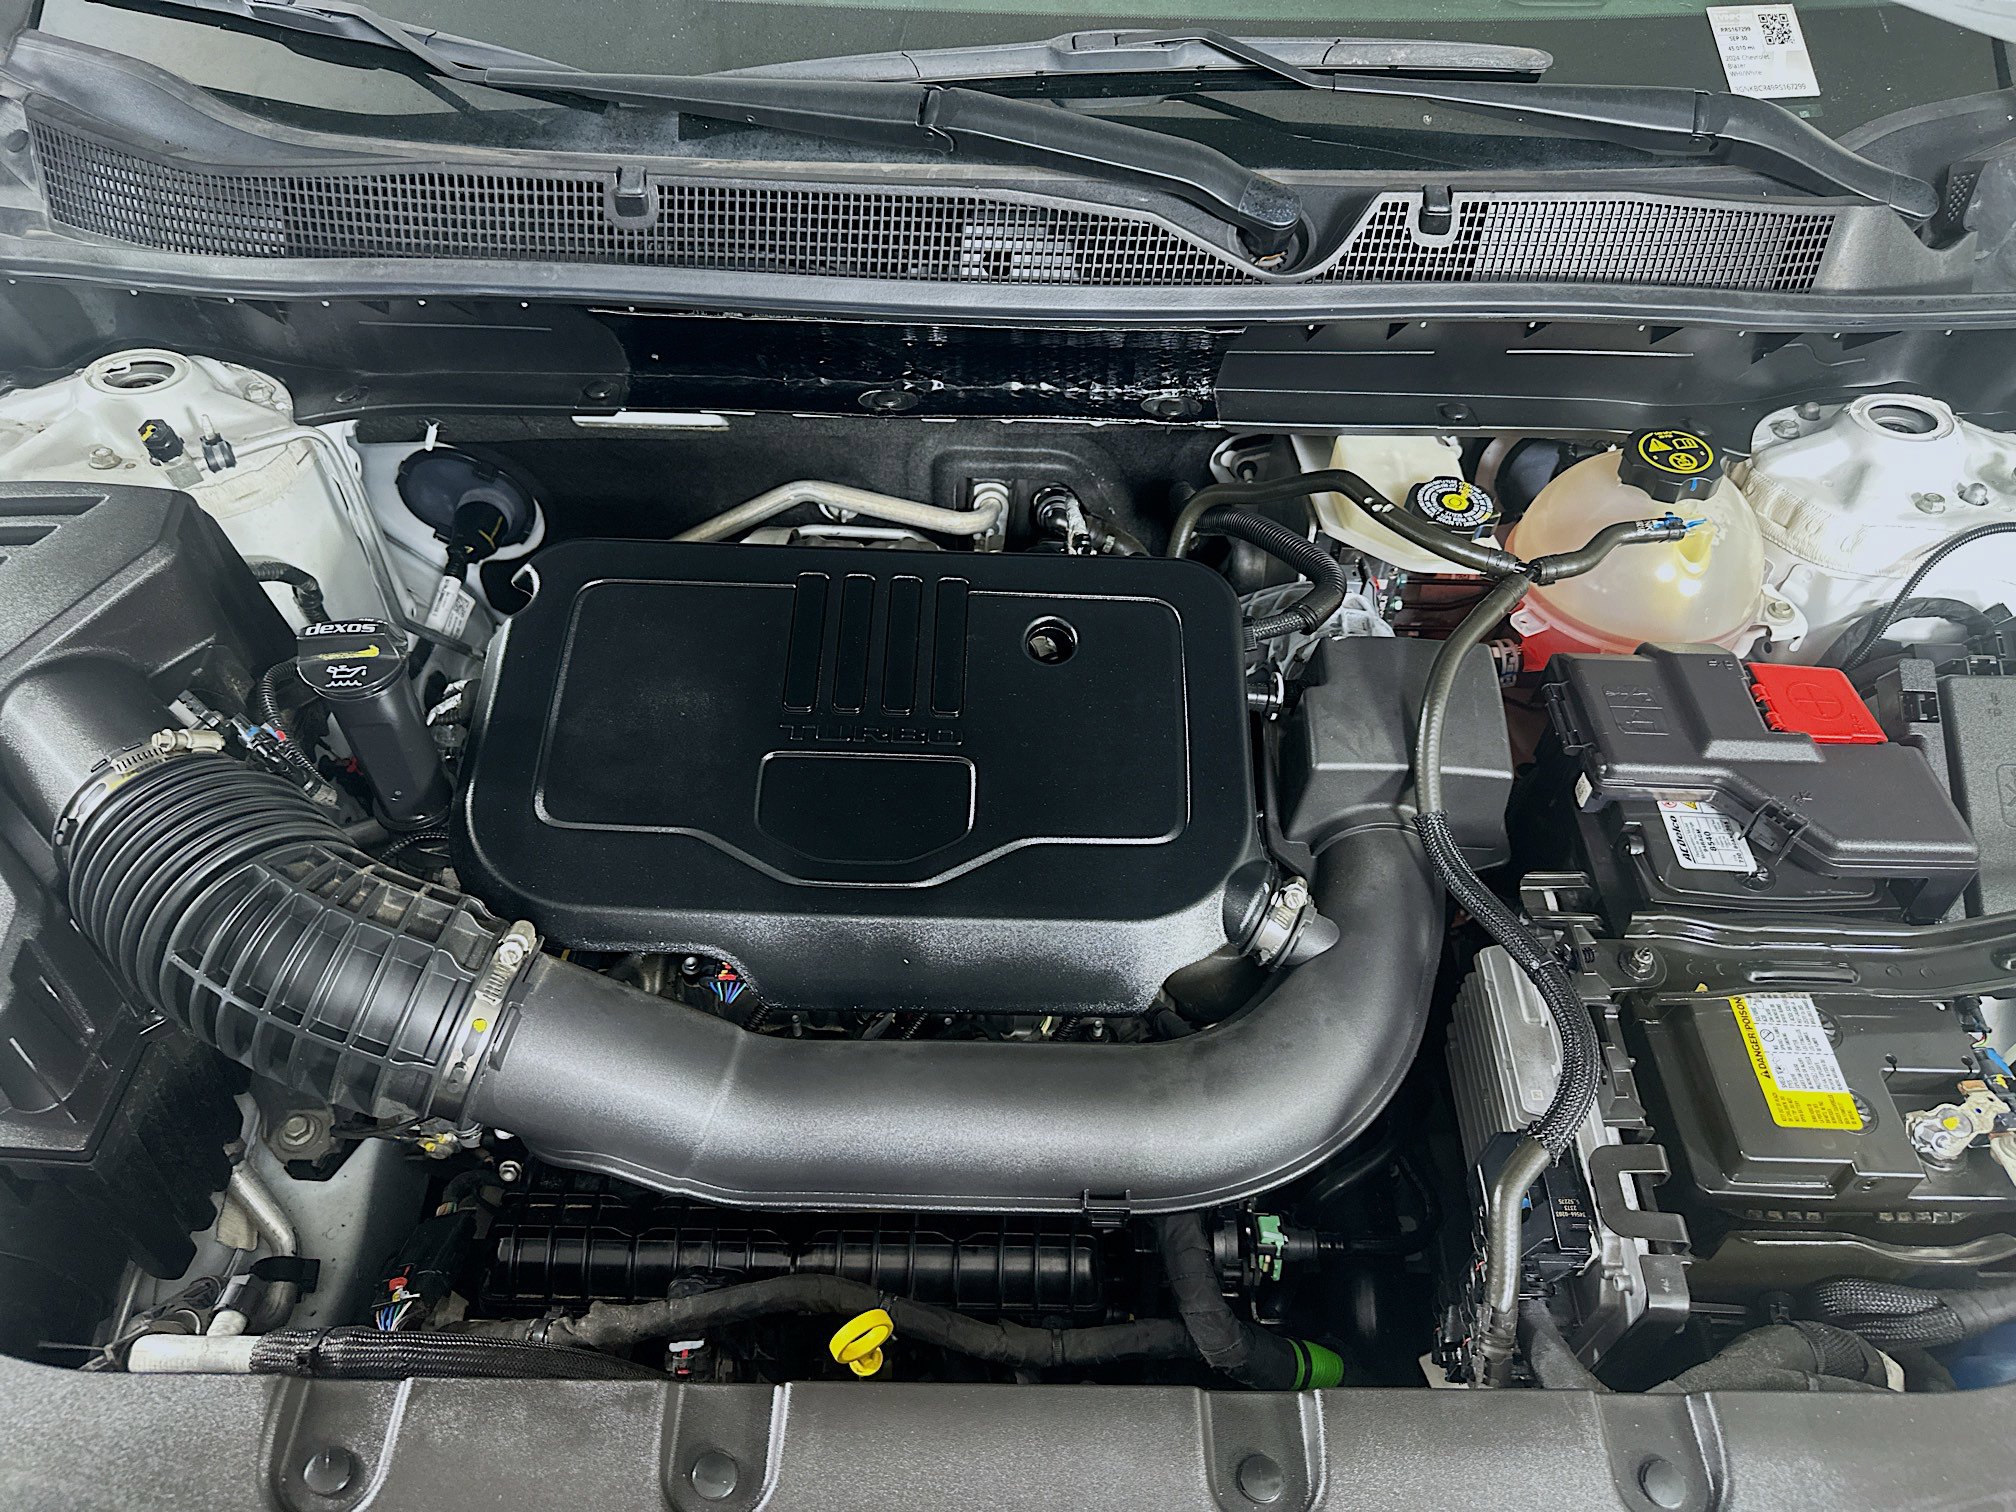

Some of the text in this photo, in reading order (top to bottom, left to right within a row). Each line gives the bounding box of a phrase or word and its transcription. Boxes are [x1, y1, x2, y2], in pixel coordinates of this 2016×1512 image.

[305, 623, 376, 636] dexos
[780, 724, 963, 745] TURBO
[1669, 815, 1691, 861] ACDelco
[1733, 997, 1767, 1068] DANGER/POISON
